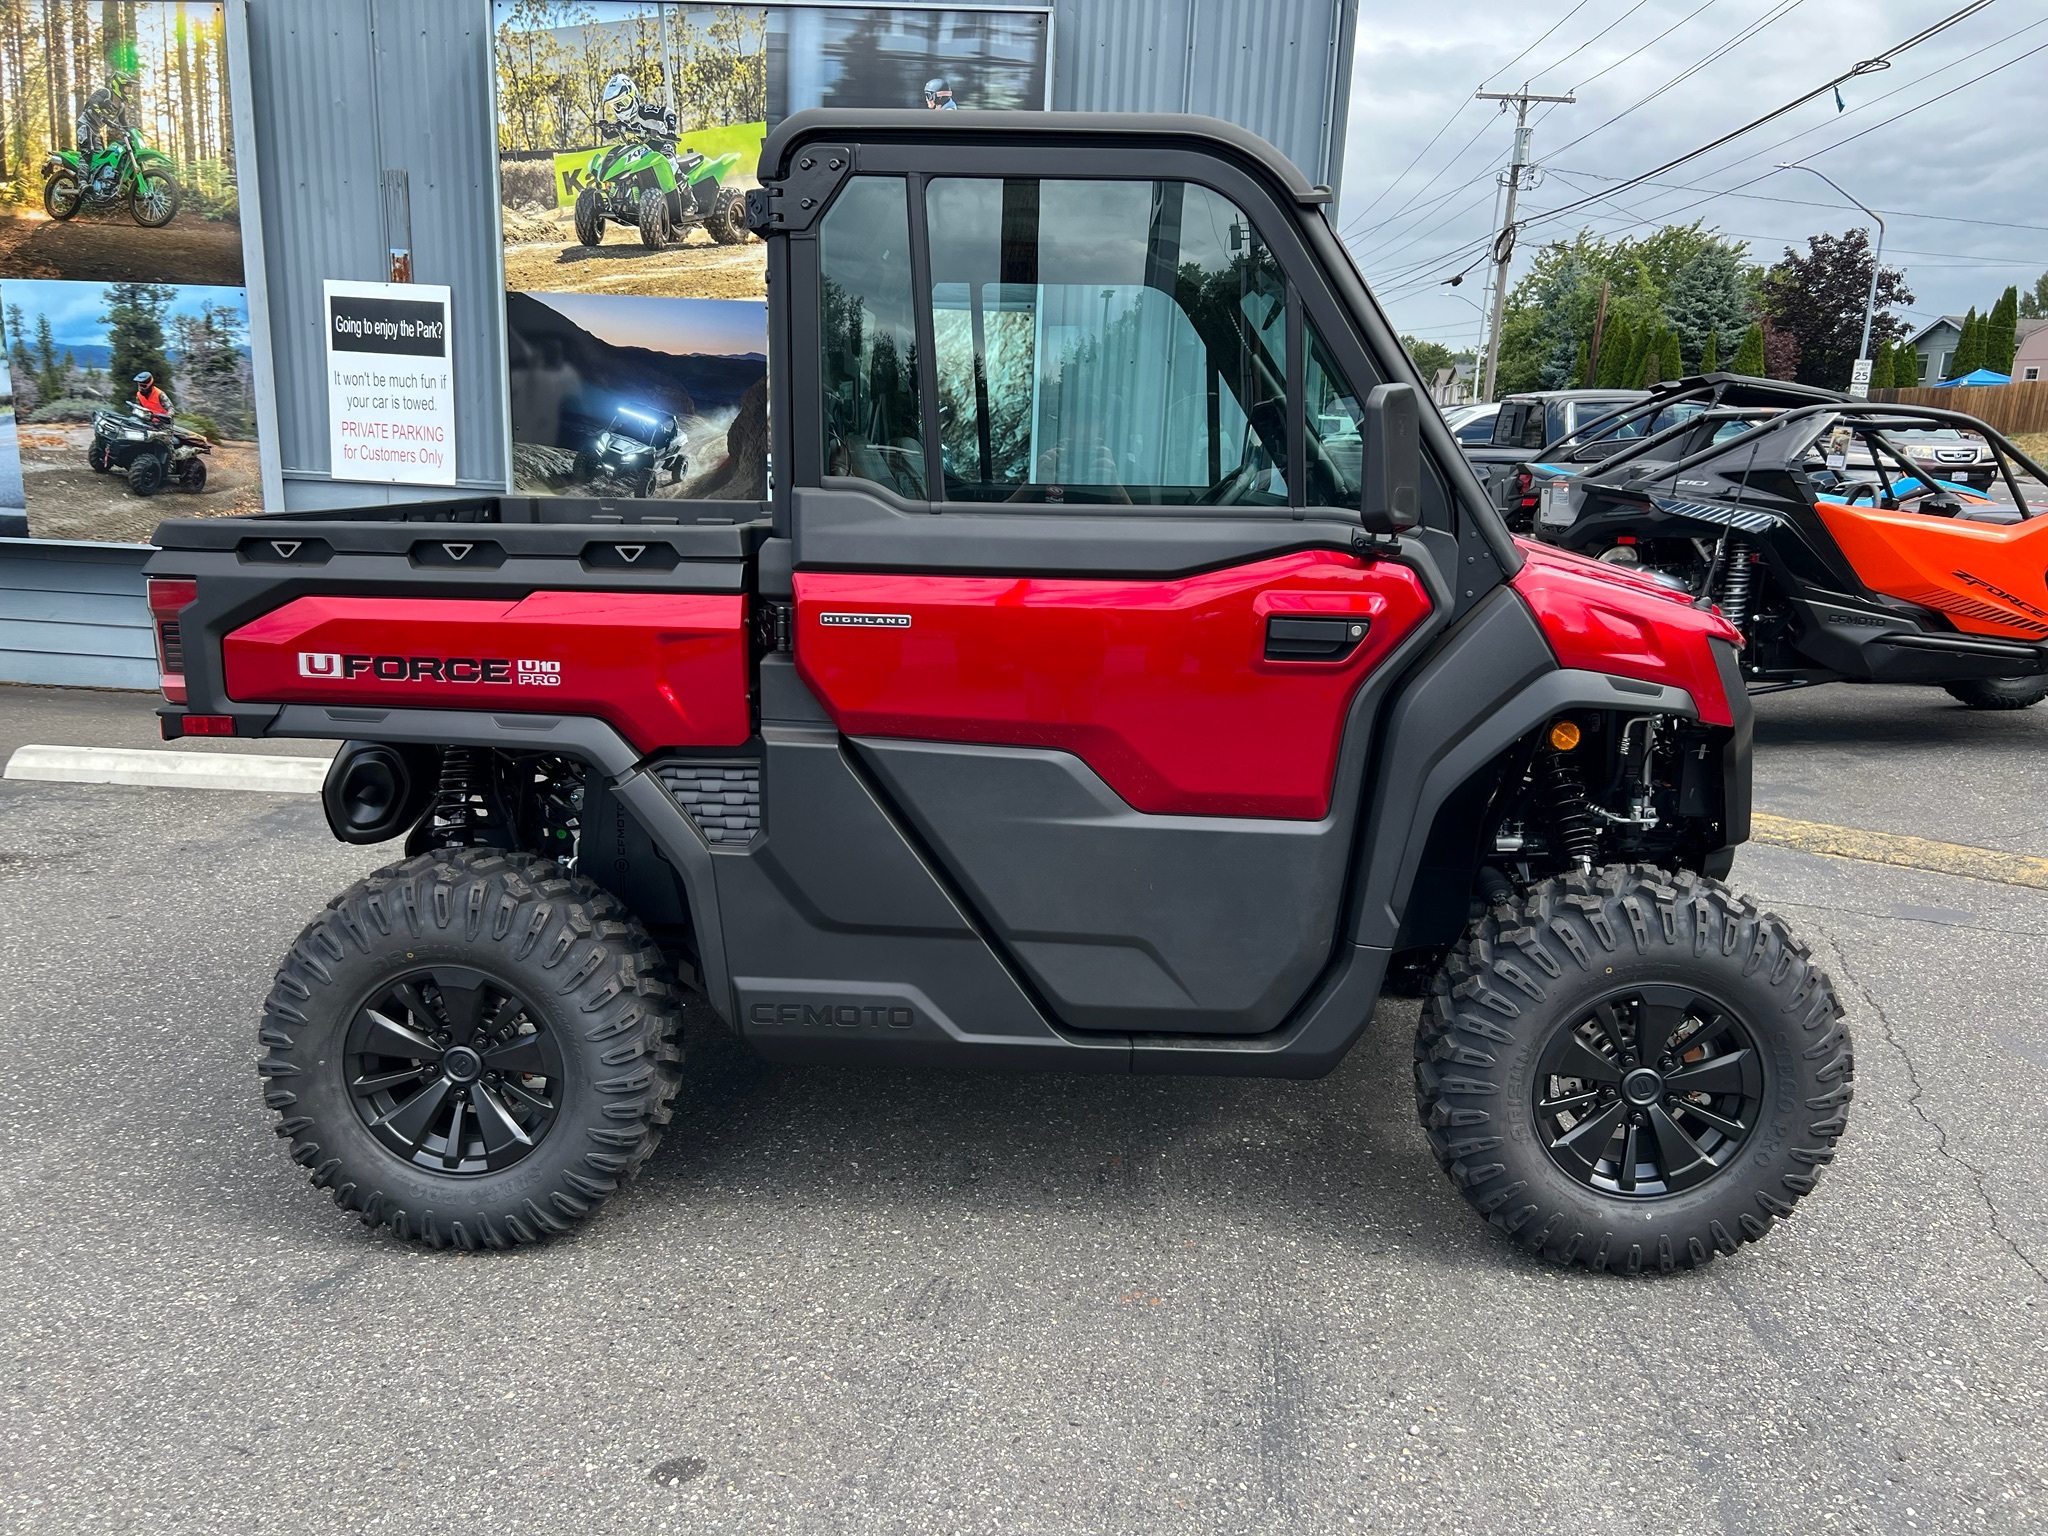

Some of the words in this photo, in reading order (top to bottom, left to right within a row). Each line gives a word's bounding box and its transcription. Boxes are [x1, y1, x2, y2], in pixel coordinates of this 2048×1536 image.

[335, 315, 362, 338] Going
[363, 317, 373, 335] to
[374, 318, 399, 341] enjoy
[400, 320, 415, 338] the
[416, 320, 443, 339] Park?
[334, 370, 341, 386] It
[343, 372, 371, 388] won't
[372, 372, 386, 388] be
[389, 374, 418, 389] much
[420, 373, 437, 390] fun
[440, 374, 447, 390] if
[1854, 371, 1868, 381] 25
[346, 396, 370, 412] your
[372, 396, 389, 409] car
[391, 394, 400, 410] is
[402, 395, 438, 412] towed.
[341, 421, 389, 440] PRIVATE
[392, 424, 445, 443] PARKING
[343, 443, 358, 460] for
[360, 444, 417, 464] Customers
[419, 447, 444, 469] Only
[823, 616, 908, 625] HIGHLAND
[1828, 614, 1886, 629] CFMOTO
[517, 659, 561, 673] U10
[518, 673, 561, 686] PRO
[750, 1003, 914, 1029] CFMOTO
